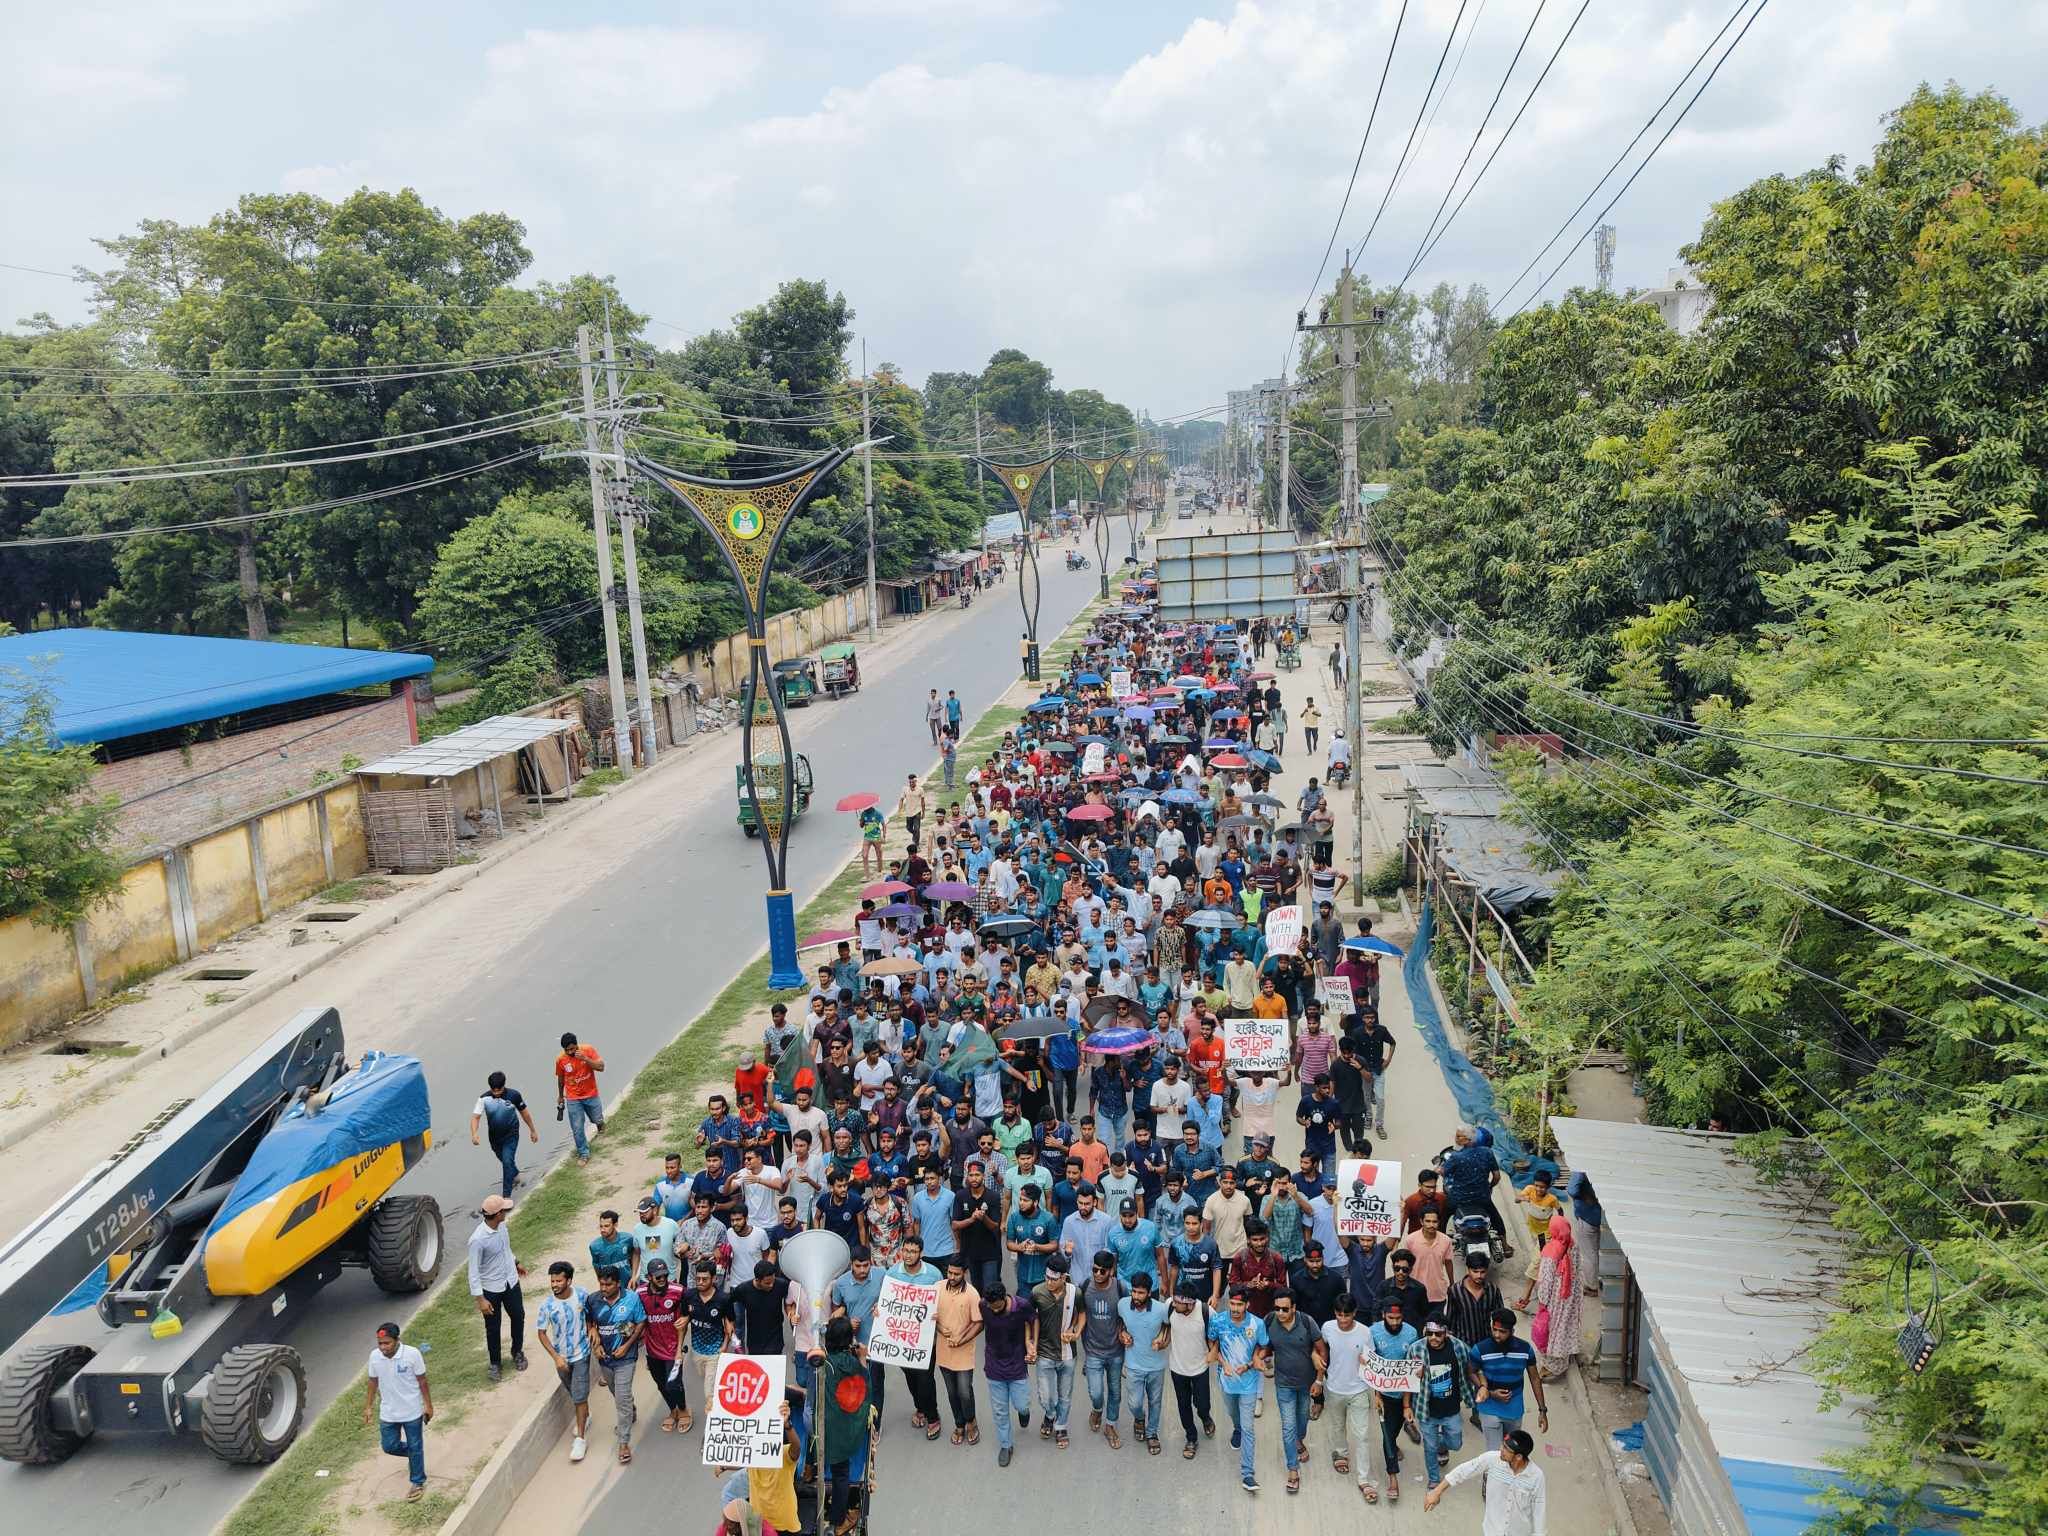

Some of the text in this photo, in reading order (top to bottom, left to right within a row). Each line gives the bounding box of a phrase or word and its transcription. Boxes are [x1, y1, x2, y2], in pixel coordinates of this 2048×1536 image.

[1270, 906, 1297, 922] DOWN
[1271, 923, 1292, 935] WITH
[1230, 1036, 1272, 1049] কোটার
[1344, 1195, 1388, 1212] কোটা
[1340, 1218, 1392, 1235] লাল কার্ড
[889, 1282, 937, 1304] সংবিধান
[886, 1317, 920, 1331] QUOTA
[870, 1334, 928, 1362] নিপাত যাক
[1366, 1359, 1415, 1377] AGAINST
[1364, 1368, 1410, 1389] QUOTA
[725, 1372, 767, 1404] 96%
[709, 1417, 782, 1434] PEOPLE
[707, 1433, 753, 1446] AGAINST
[706, 1445, 752, 1464] QUOTA
